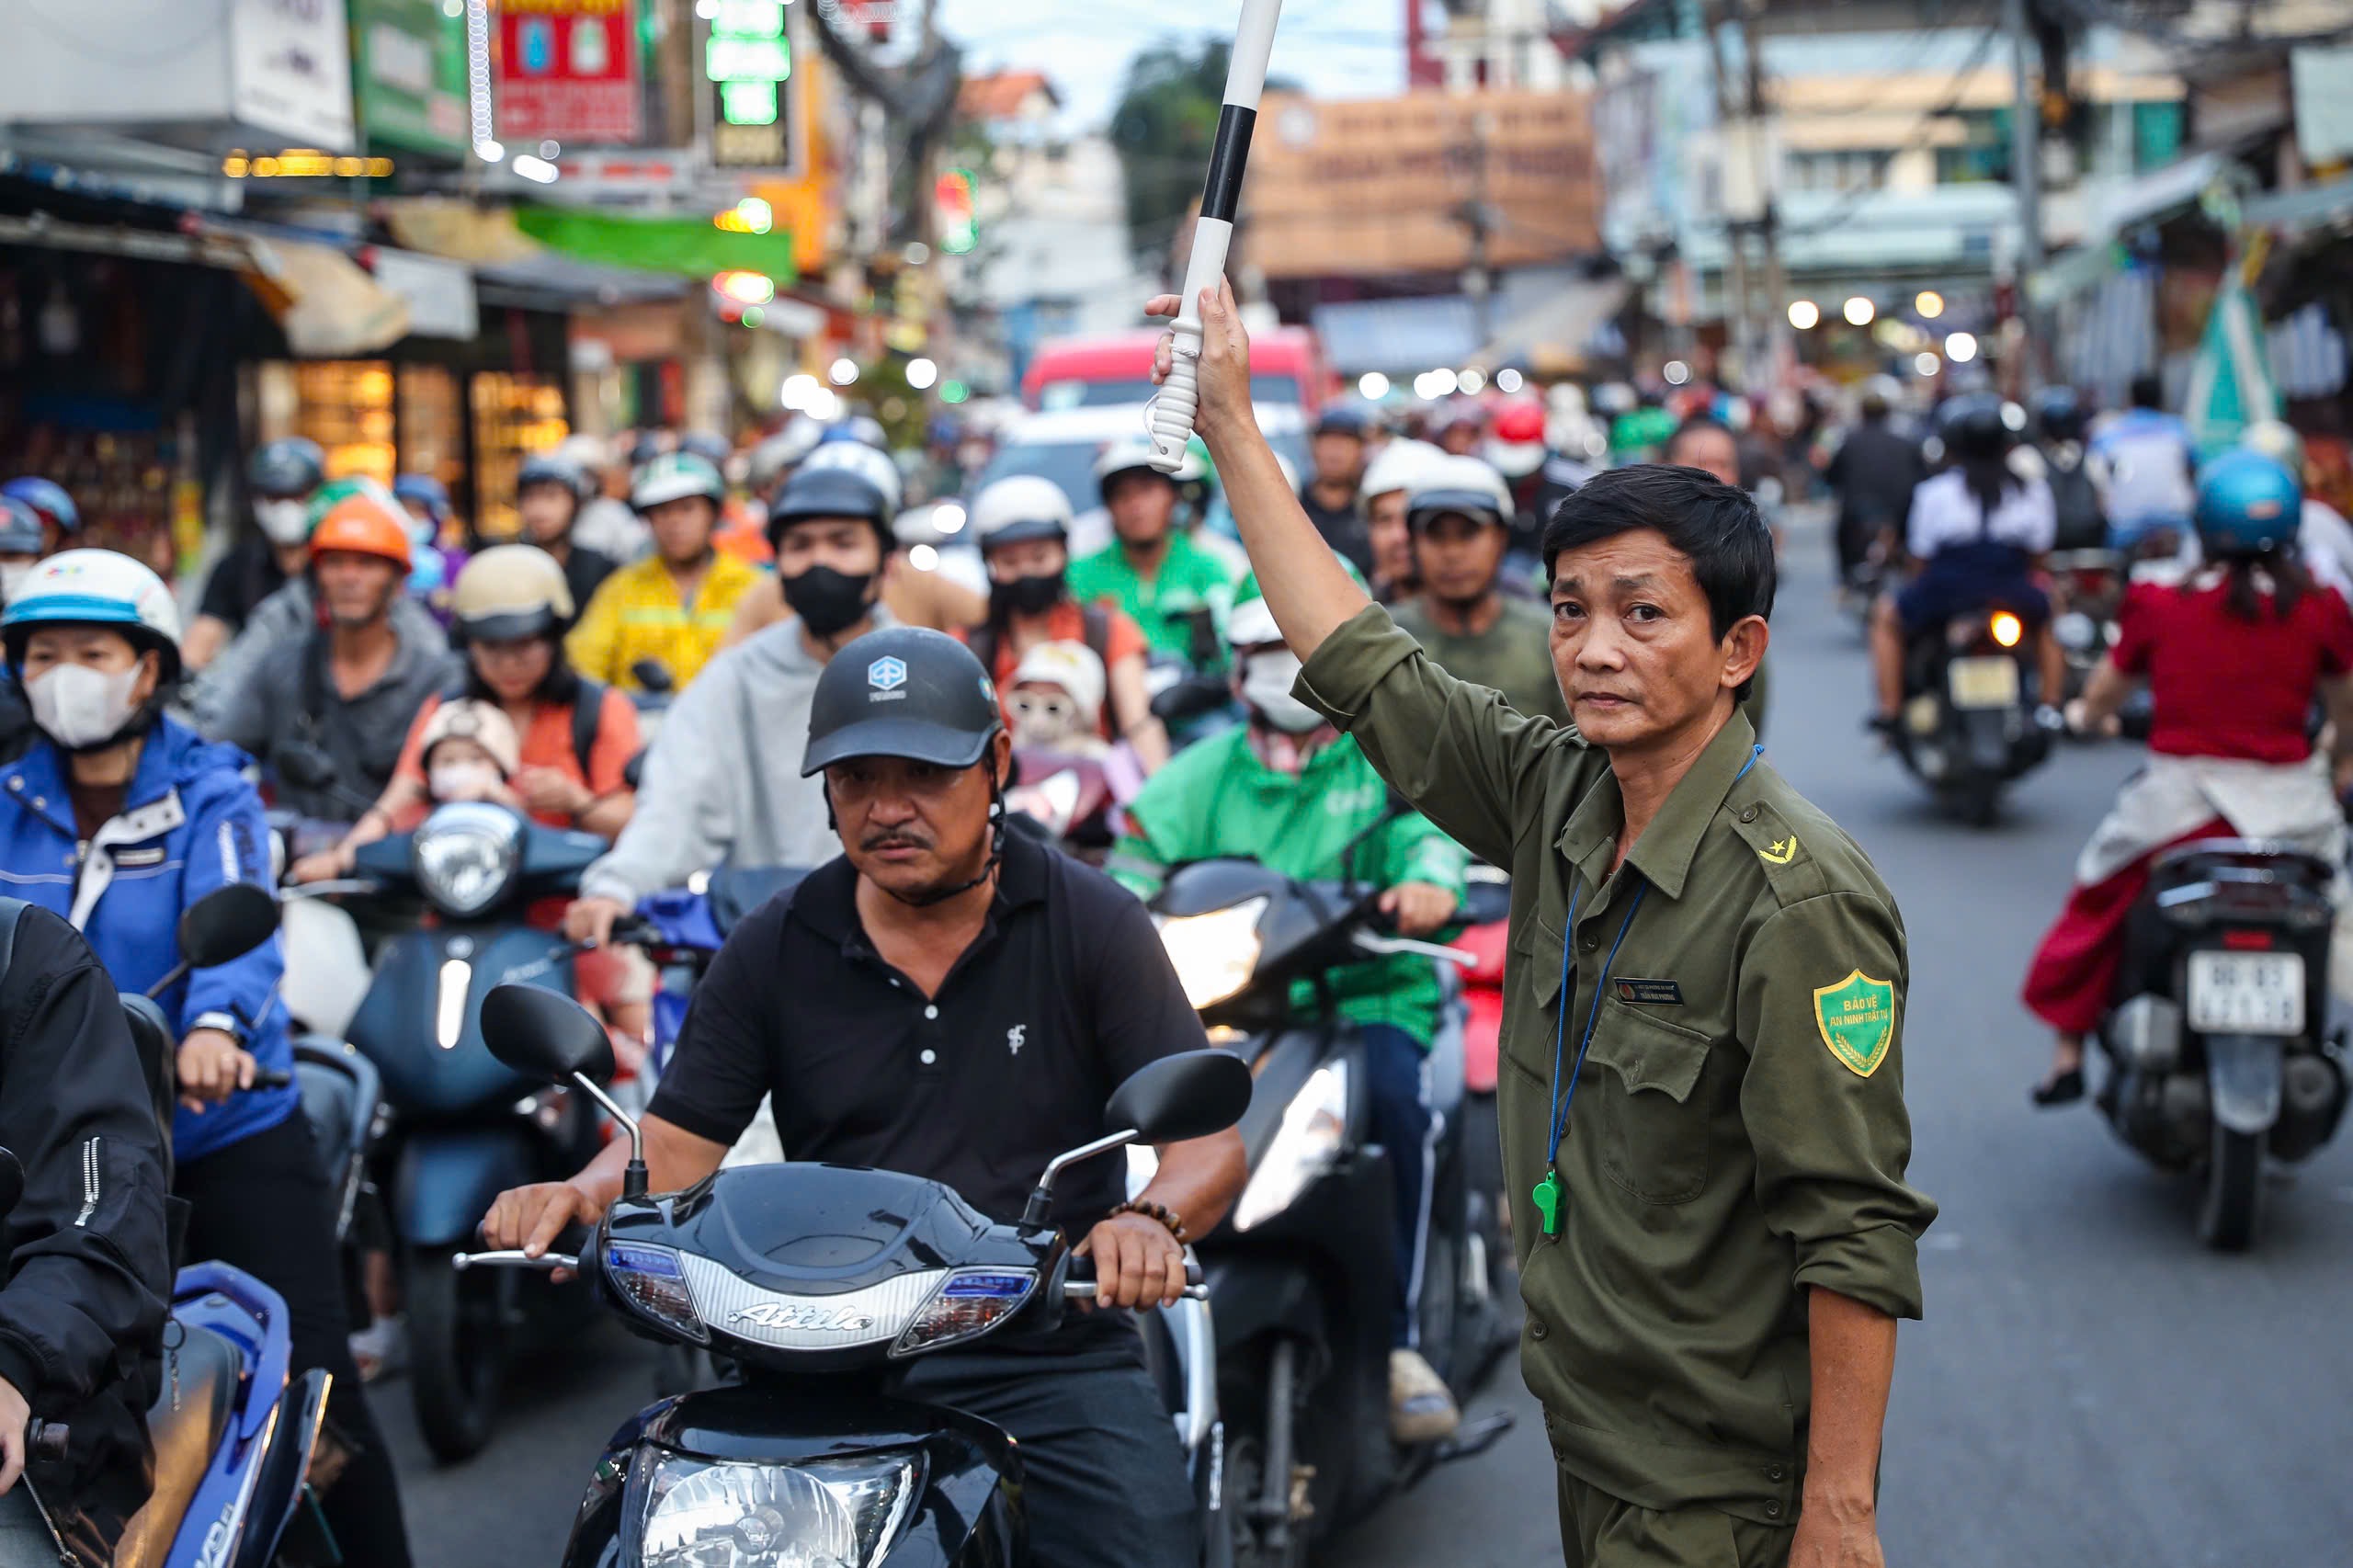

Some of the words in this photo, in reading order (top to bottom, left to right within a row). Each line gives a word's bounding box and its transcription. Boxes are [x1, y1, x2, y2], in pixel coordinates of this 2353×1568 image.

[1844, 996, 1865, 1011] BẢO
[1866, 994, 1878, 1009] VỆ
[1830, 1016, 1843, 1027] AN
[1844, 1013, 1864, 1025] NINH
